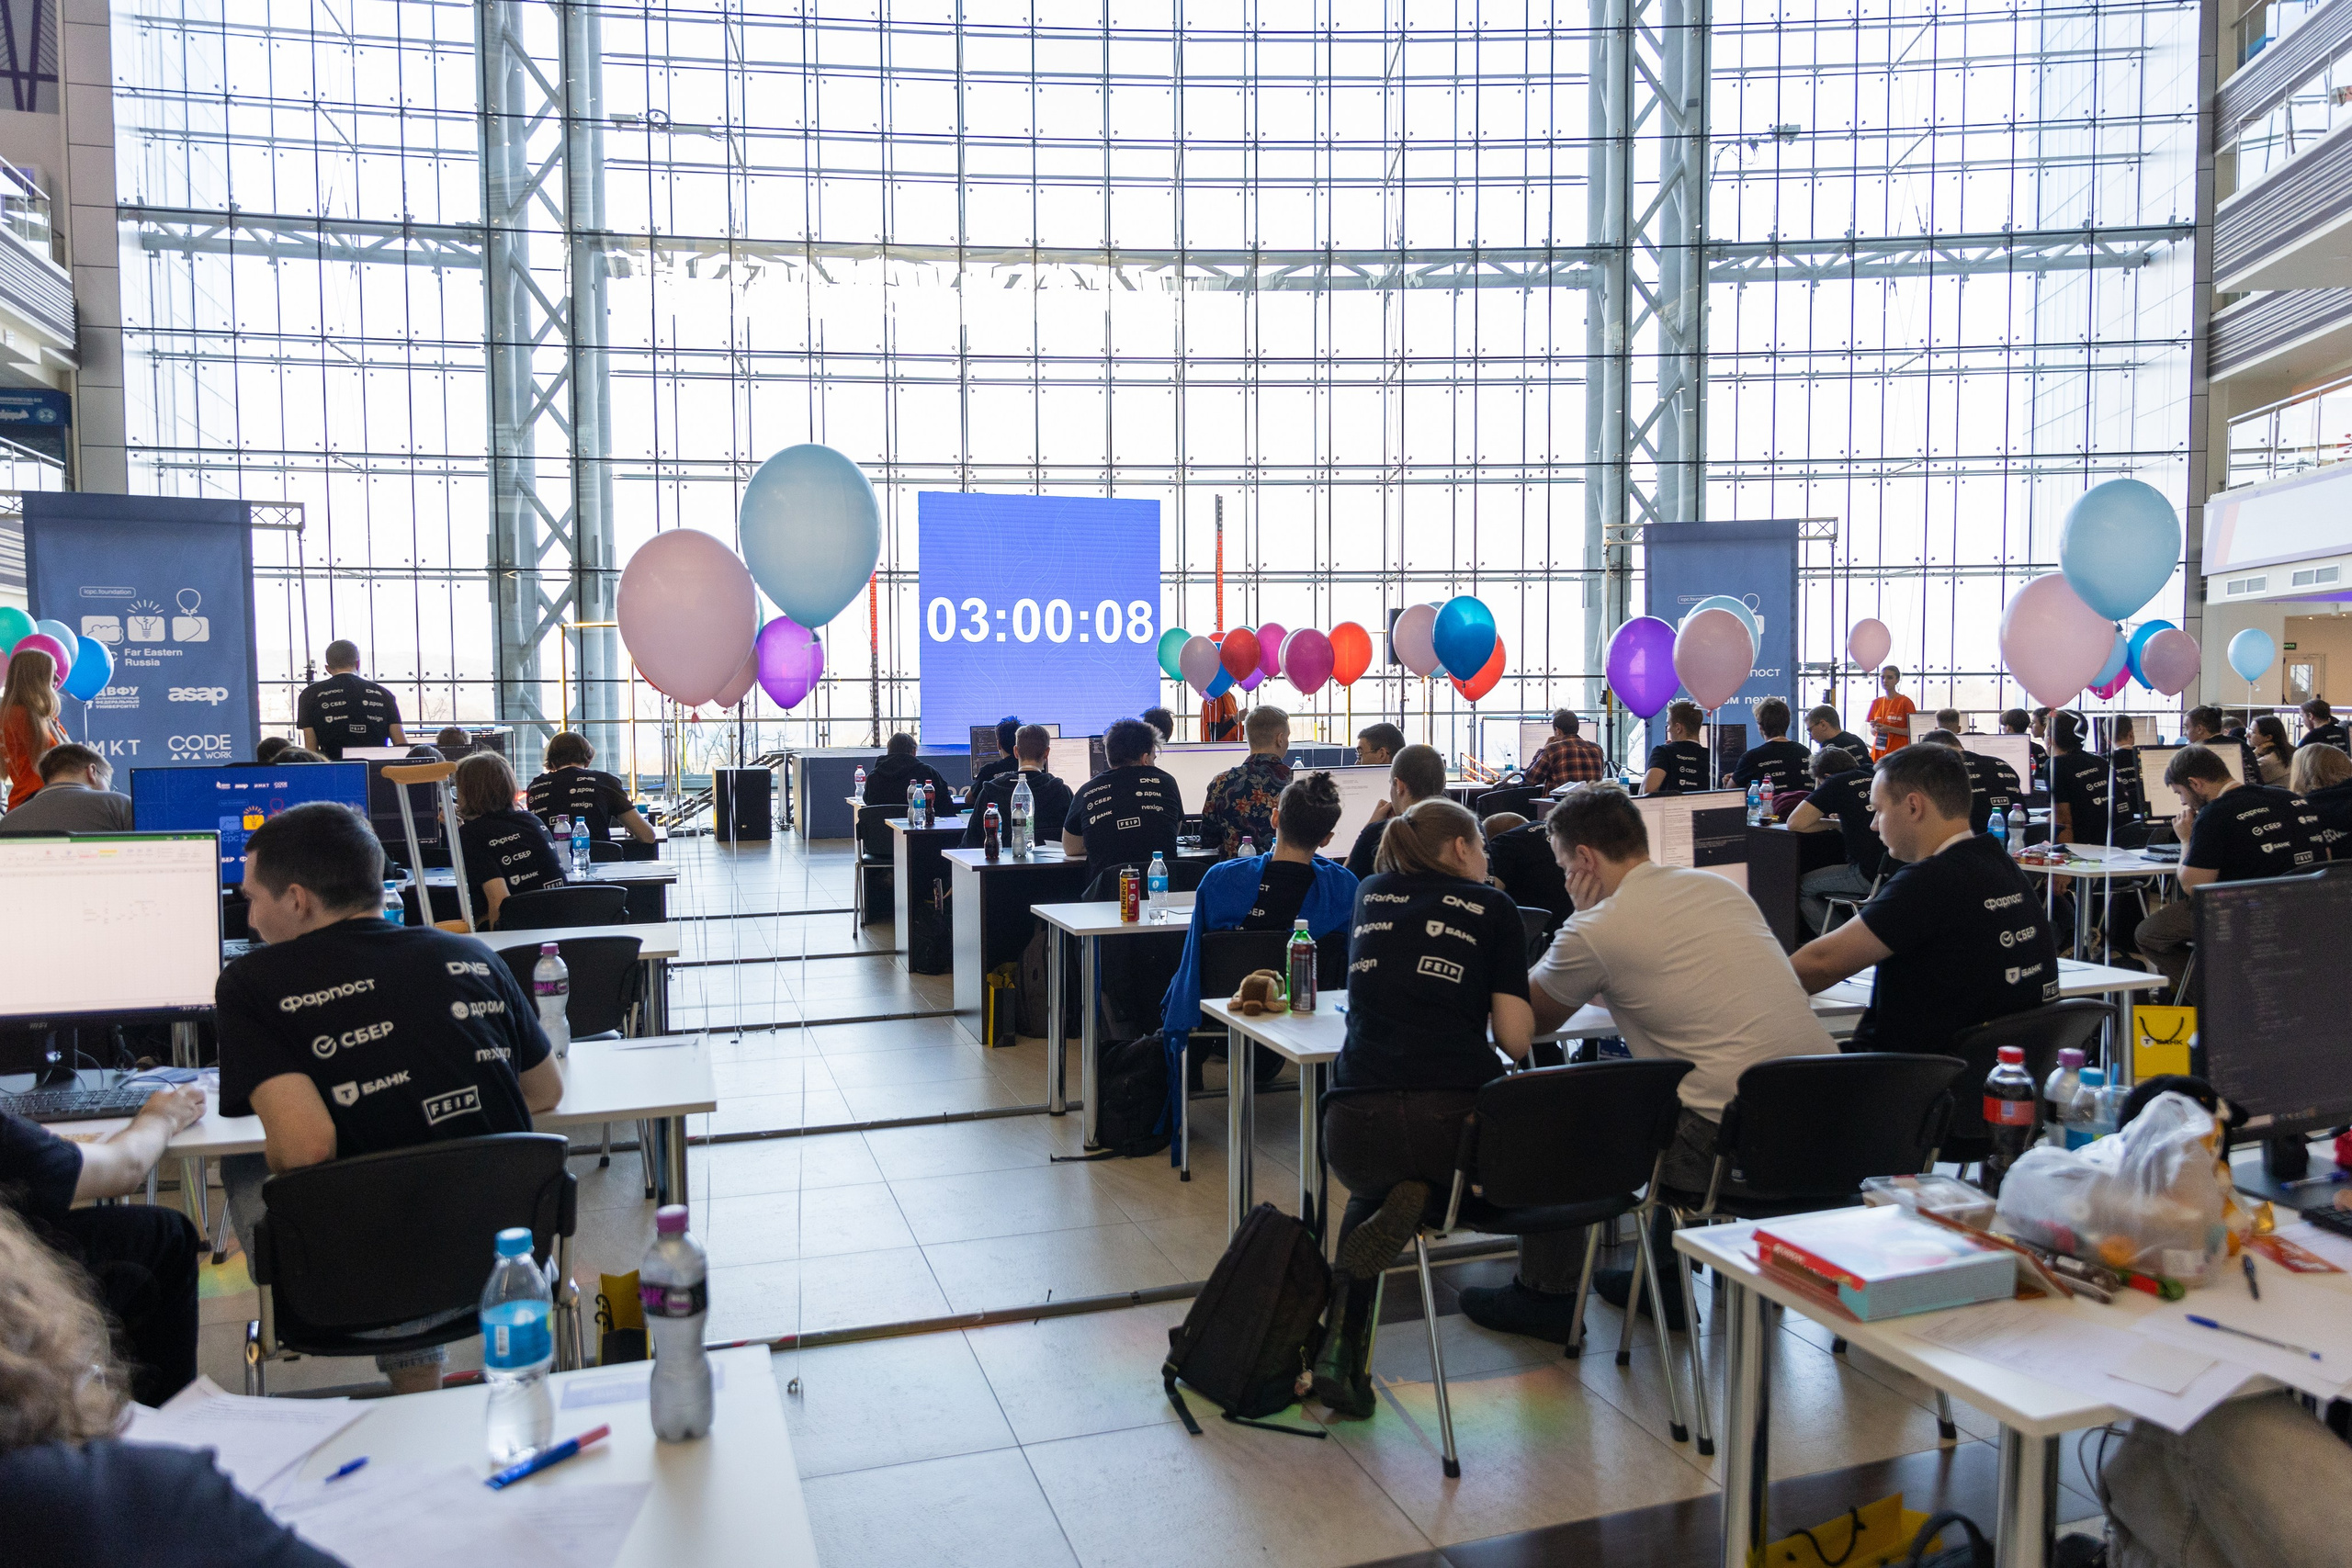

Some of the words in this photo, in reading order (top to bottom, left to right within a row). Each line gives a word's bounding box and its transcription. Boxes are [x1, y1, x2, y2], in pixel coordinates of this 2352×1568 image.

[926, 597, 1154, 643] 03:00:08
[124, 649, 141, 657] Far
[143, 649, 183, 657] Eastern
[1748, 669, 1781, 678] пост
[168, 687, 229, 705] asap
[77, 739, 141, 756] МКТ
[168, 734, 232, 751] CODE
[204, 751, 232, 760] WORK
[222, 835, 239, 844] cpc
[513, 850, 532, 861] СБЕР
[1442, 895, 1486, 916] DNS
[1984, 893, 2023, 911] фарпост
[1248, 908, 1265, 918] ЕР
[1444, 926, 1477, 946] БАНК
[2016, 926, 2037, 942] СБЕР
[446, 961, 491, 976] DNS
[1424, 960, 1459, 976] FEIP
[278, 978, 376, 1013] фарпост
[340, 1021, 394, 1049] СБЕР
[361, 1070, 412, 1097] БАНК
[429, 1095, 477, 1119] FEIP
